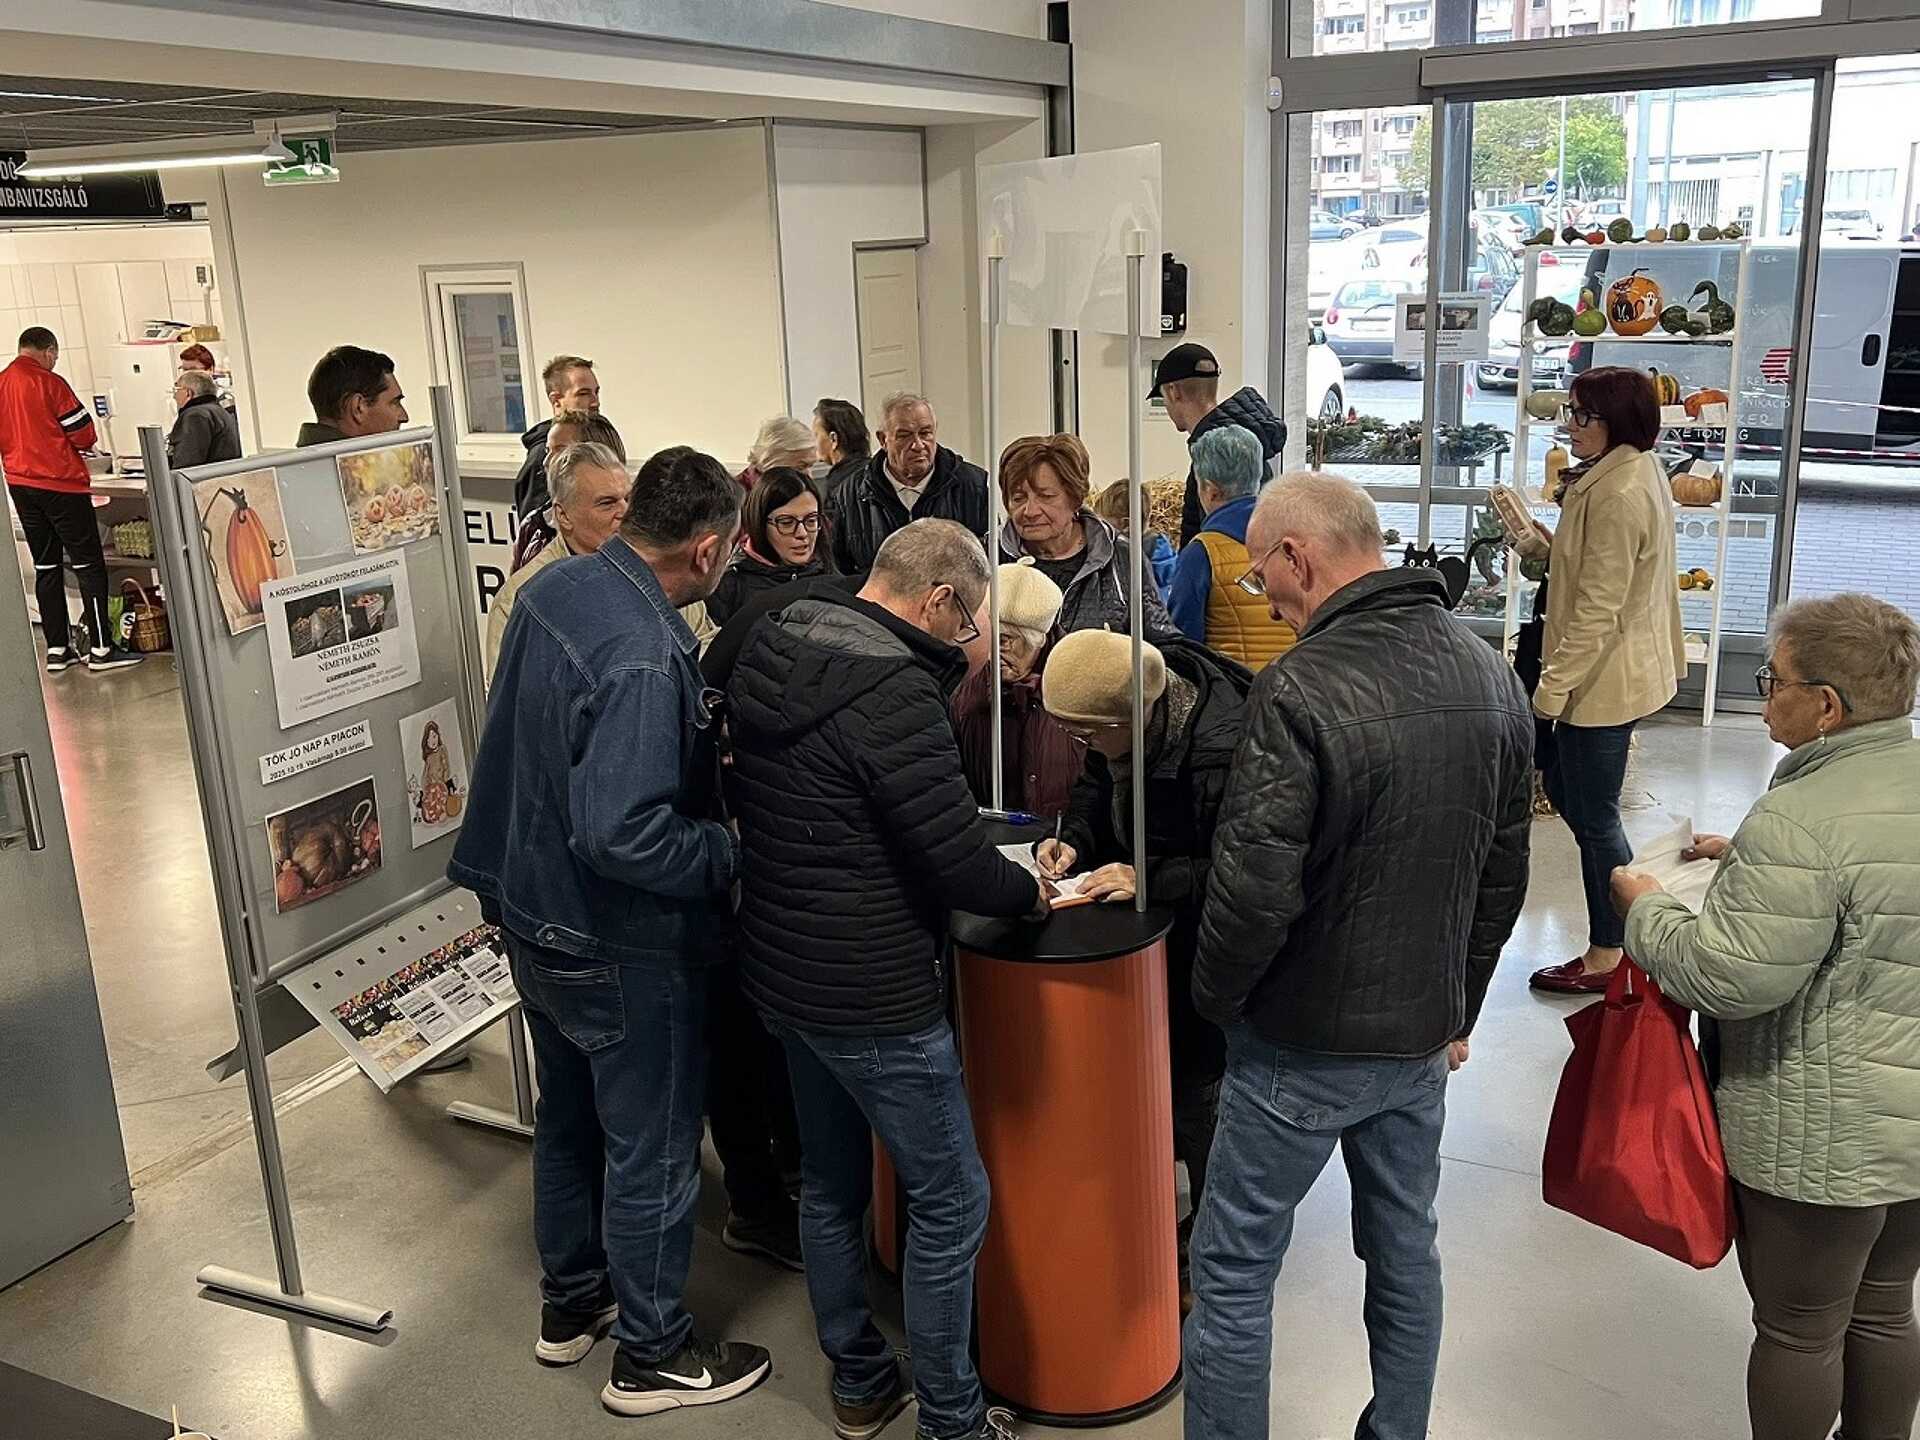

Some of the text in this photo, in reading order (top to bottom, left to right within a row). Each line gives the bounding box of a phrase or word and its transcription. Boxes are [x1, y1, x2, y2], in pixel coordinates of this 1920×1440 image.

[351, 636, 380, 651] ZSUZSA
[302, 740, 322, 754] NAP
[323, 737, 331, 748] A
[331, 724, 365, 744] PIACON
